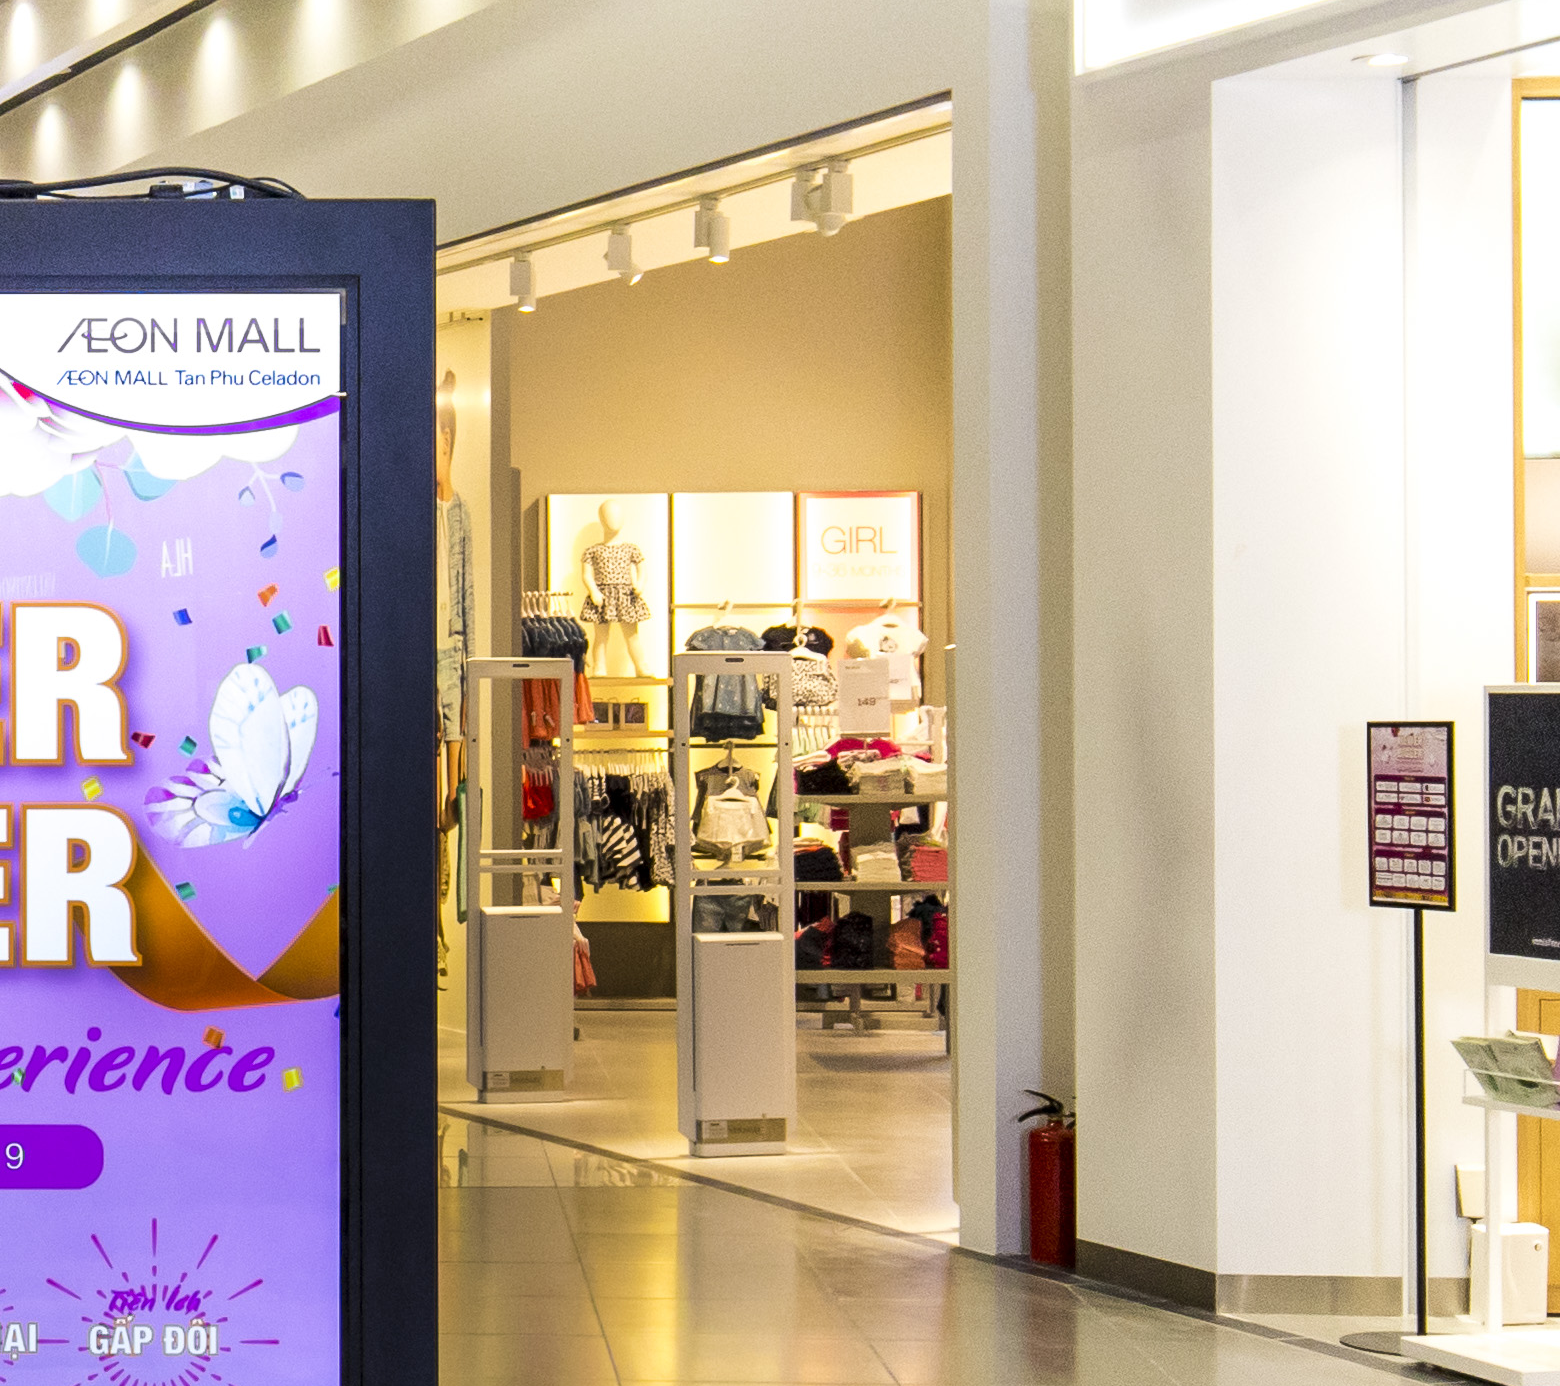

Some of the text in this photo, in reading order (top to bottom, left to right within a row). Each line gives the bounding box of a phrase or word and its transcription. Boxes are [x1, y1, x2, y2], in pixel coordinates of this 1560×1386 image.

[196, 317, 321, 353] MALL
[115, 370, 168, 386] MALL
[175, 369, 206, 386] Tan
[211, 369, 244, 386] Phu
[248, 369, 321, 386] Celadon
[820, 525, 898, 555] GIRL
[87, 1313, 221, 1357] GẤP ĐÔI
